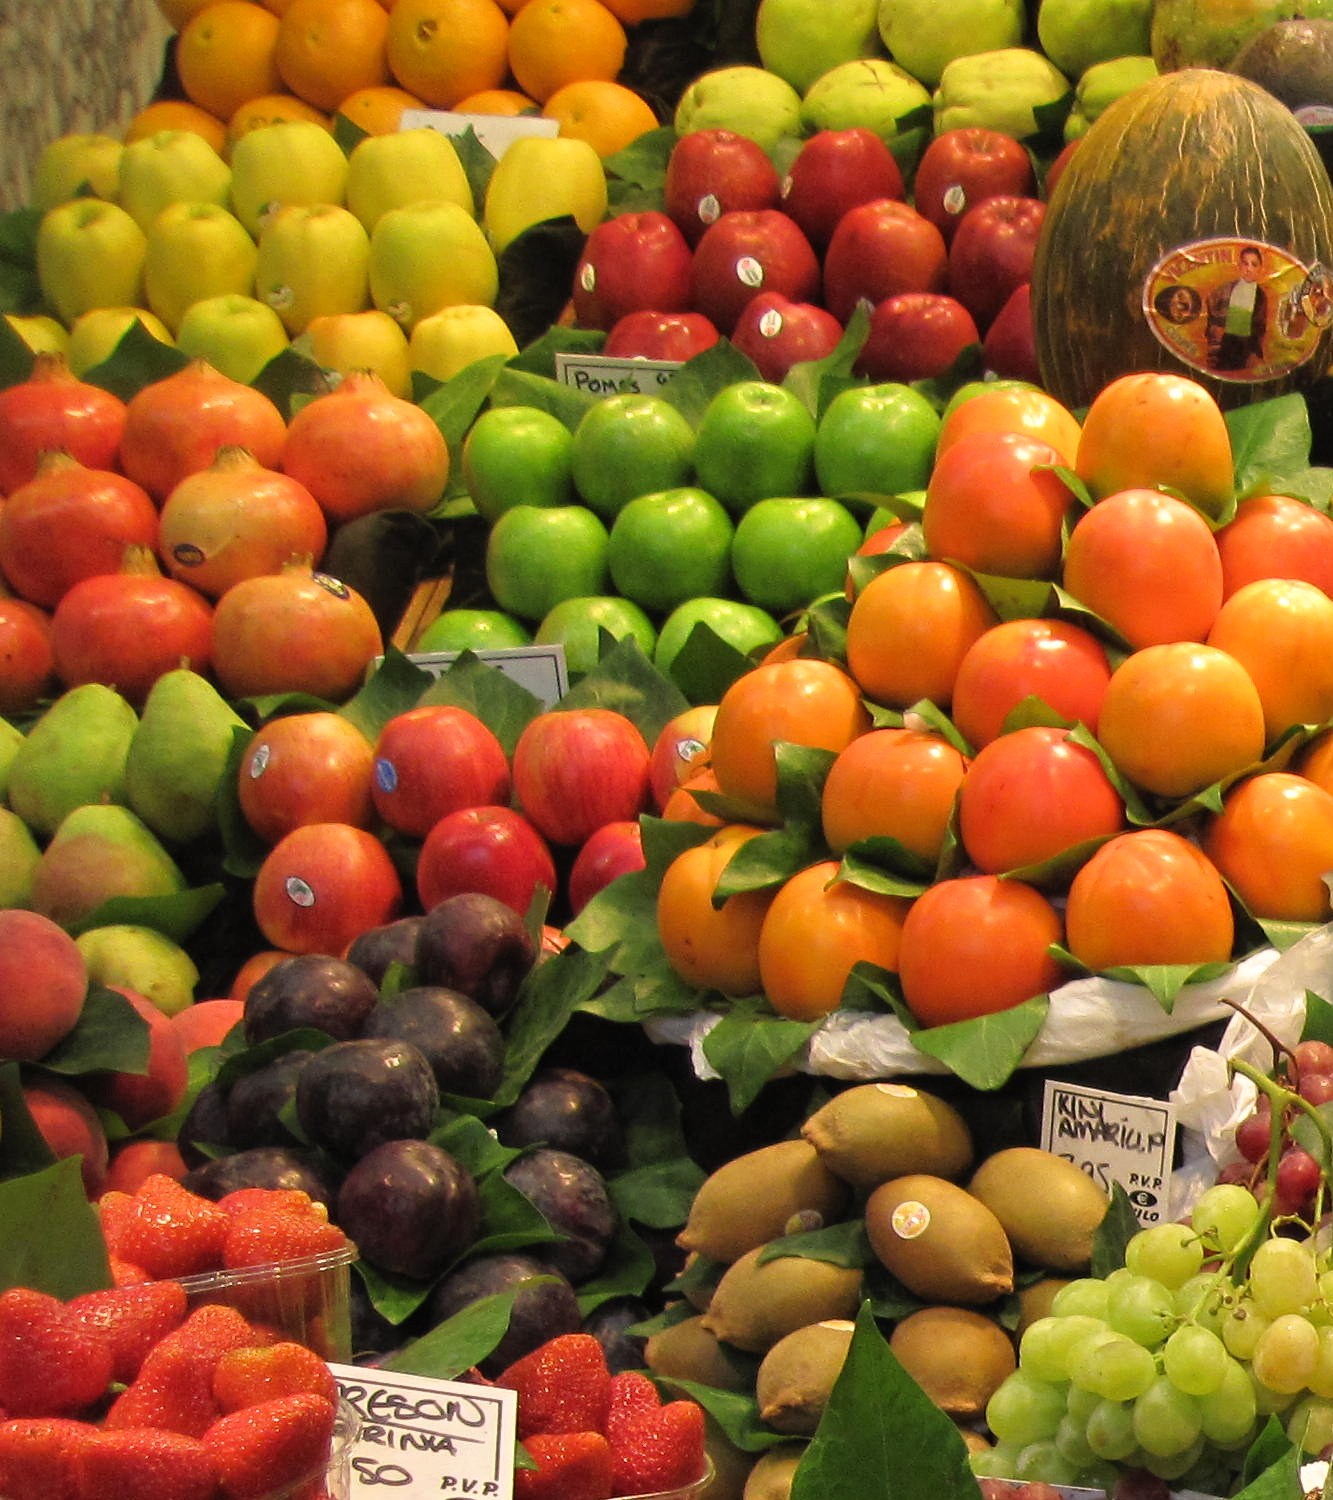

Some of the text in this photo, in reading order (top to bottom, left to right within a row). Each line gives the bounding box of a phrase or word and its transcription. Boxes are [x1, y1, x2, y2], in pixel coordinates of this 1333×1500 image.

[1135, 1208, 1160, 1223] ILO
[333, 1382, 485, 1428] RESON
[440, 1475, 500, 1498] P.V.P.
